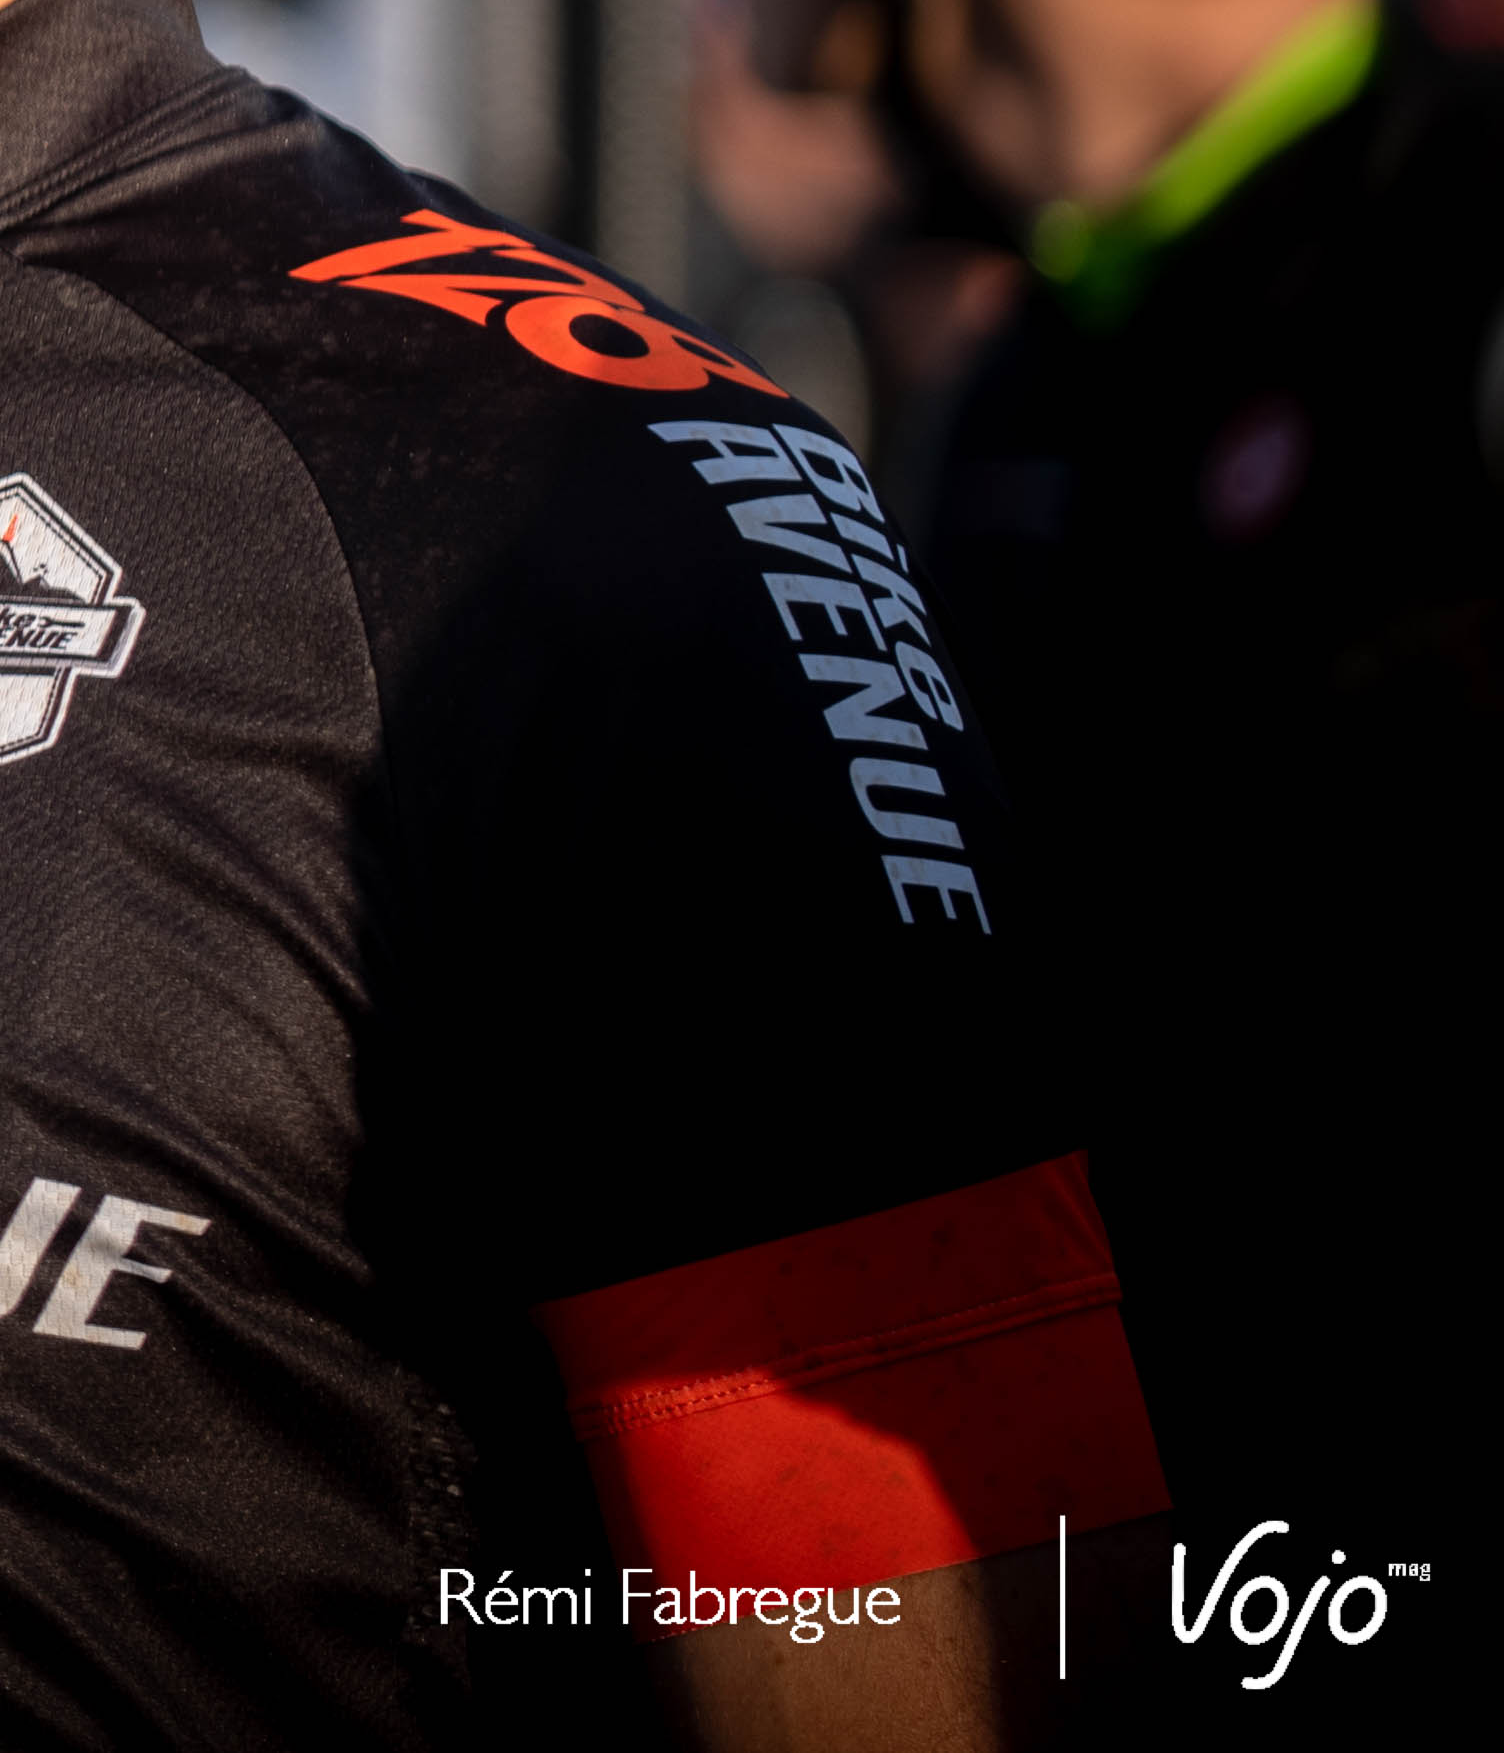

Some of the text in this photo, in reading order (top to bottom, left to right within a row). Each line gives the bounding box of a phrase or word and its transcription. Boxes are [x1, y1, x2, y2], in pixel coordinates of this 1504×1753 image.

[288, 208, 790, 398] 128
[647, 420, 992, 935] AVENUE
[772, 423, 964, 732] Bike
